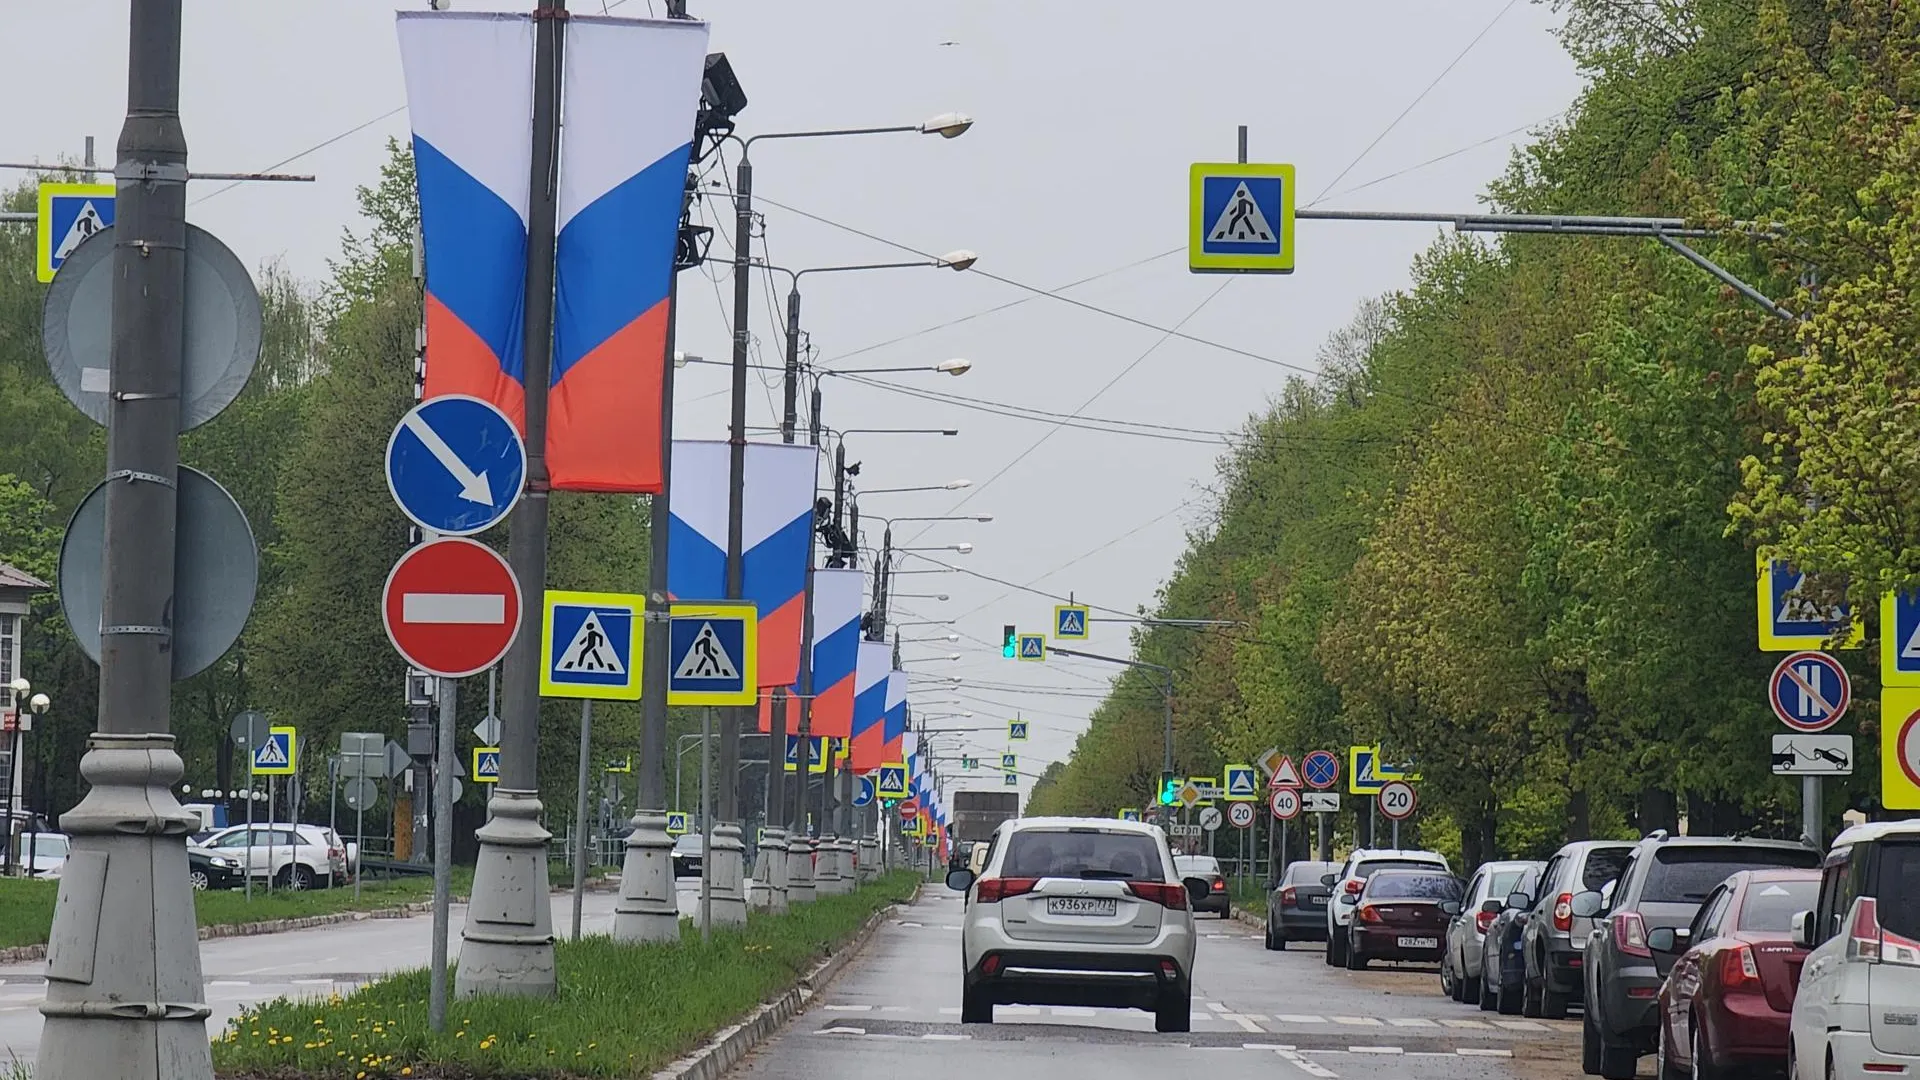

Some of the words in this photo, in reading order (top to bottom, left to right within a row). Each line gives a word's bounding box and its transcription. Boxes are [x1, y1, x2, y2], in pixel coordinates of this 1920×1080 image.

[1278, 797, 1293, 809] 40
[1387, 791, 1408, 807] 20
[1234, 808, 1249, 820] 20
[1173, 826, 1199, 835] СТОП
